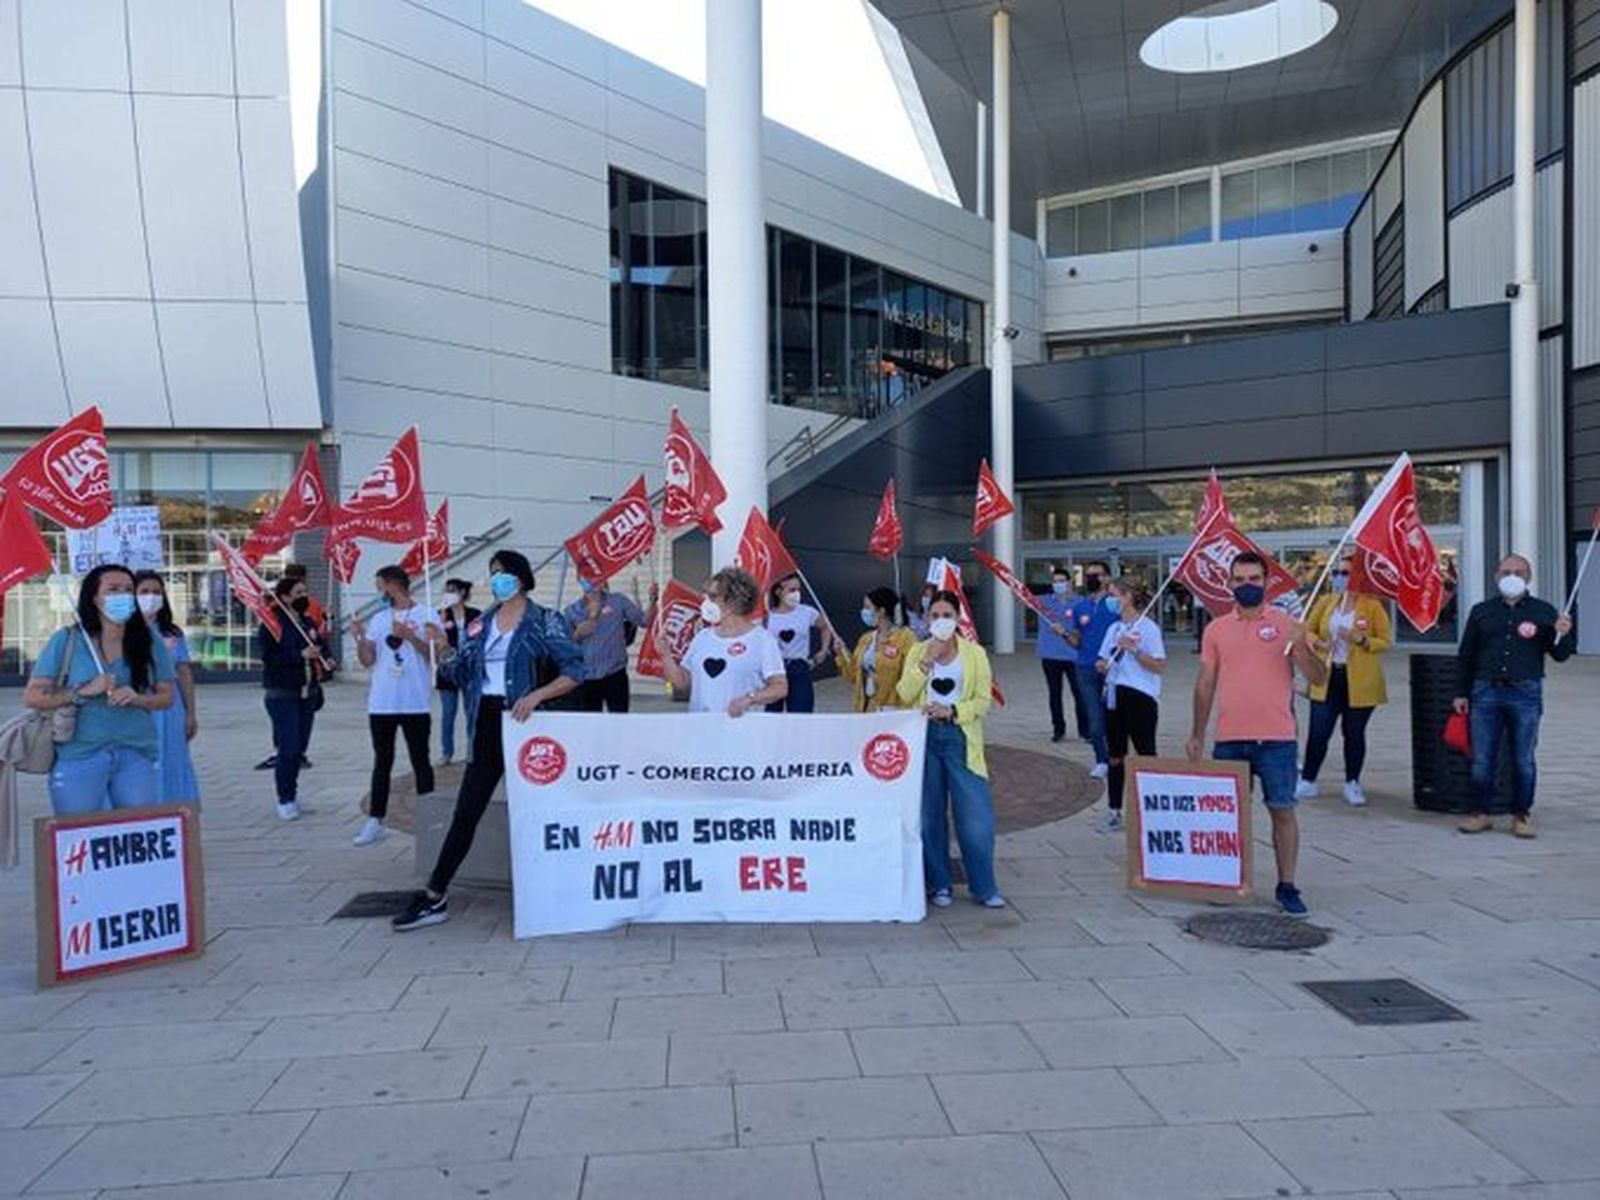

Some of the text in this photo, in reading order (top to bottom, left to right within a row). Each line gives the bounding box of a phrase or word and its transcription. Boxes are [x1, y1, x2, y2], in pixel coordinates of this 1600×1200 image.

[51, 436, 105, 491] UGT
[577, 765, 620, 781] UGT
[642, 765, 755, 781] COMERCIO
[761, 763, 854, 780] ALMERIA
[1144, 795, 1170, 811] NO
[545, 823, 580, 850] EN
[642, 820, 678, 844] NO
[693, 818, 776, 844] SOBRA
[790, 818, 856, 841] NADIE
[1147, 831, 1184, 854] NOS
[593, 857, 807, 900] NO AL ERE
